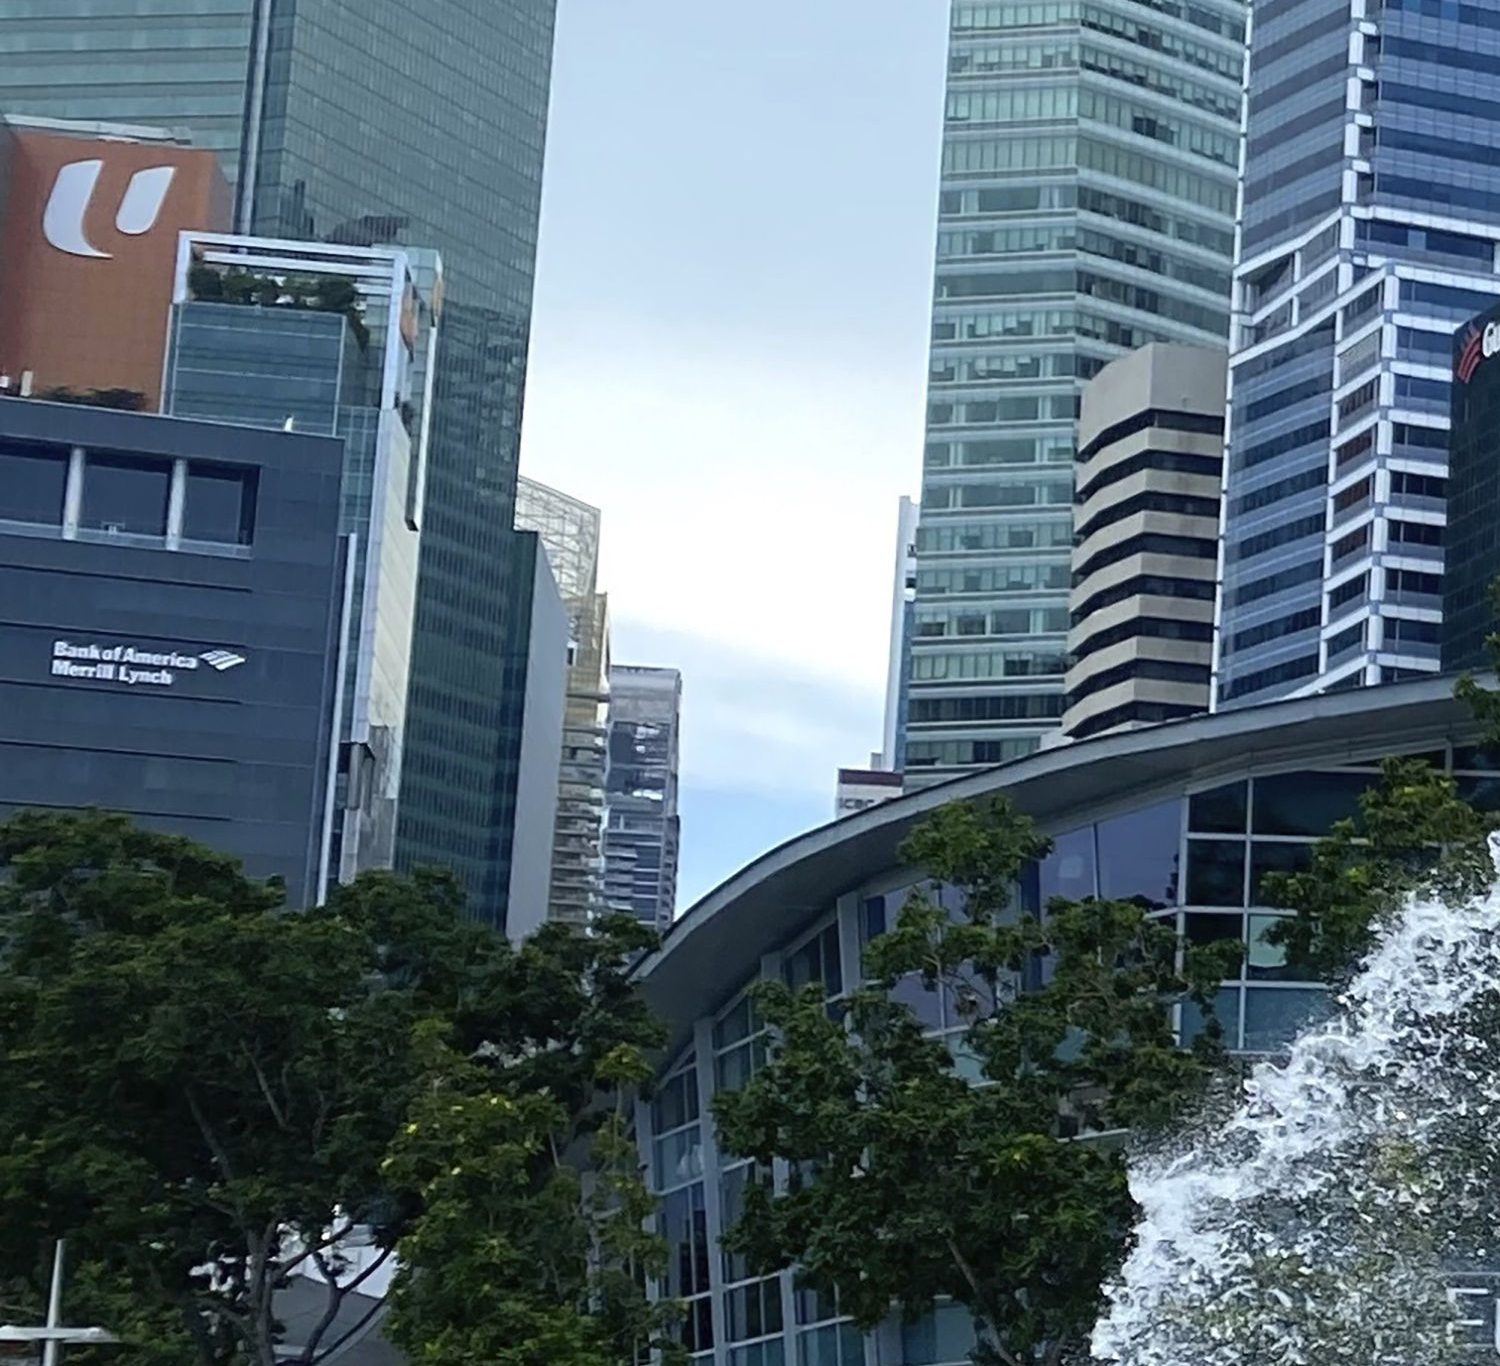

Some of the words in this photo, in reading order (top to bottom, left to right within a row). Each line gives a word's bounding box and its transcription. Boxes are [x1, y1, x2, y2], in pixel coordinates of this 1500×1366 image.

[54, 641, 100, 660] Bank
[102, 645, 124, 662] of
[123, 647, 198, 670] America
[52, 659, 114, 681] Merrill
[118, 664, 172, 685] Lynch
